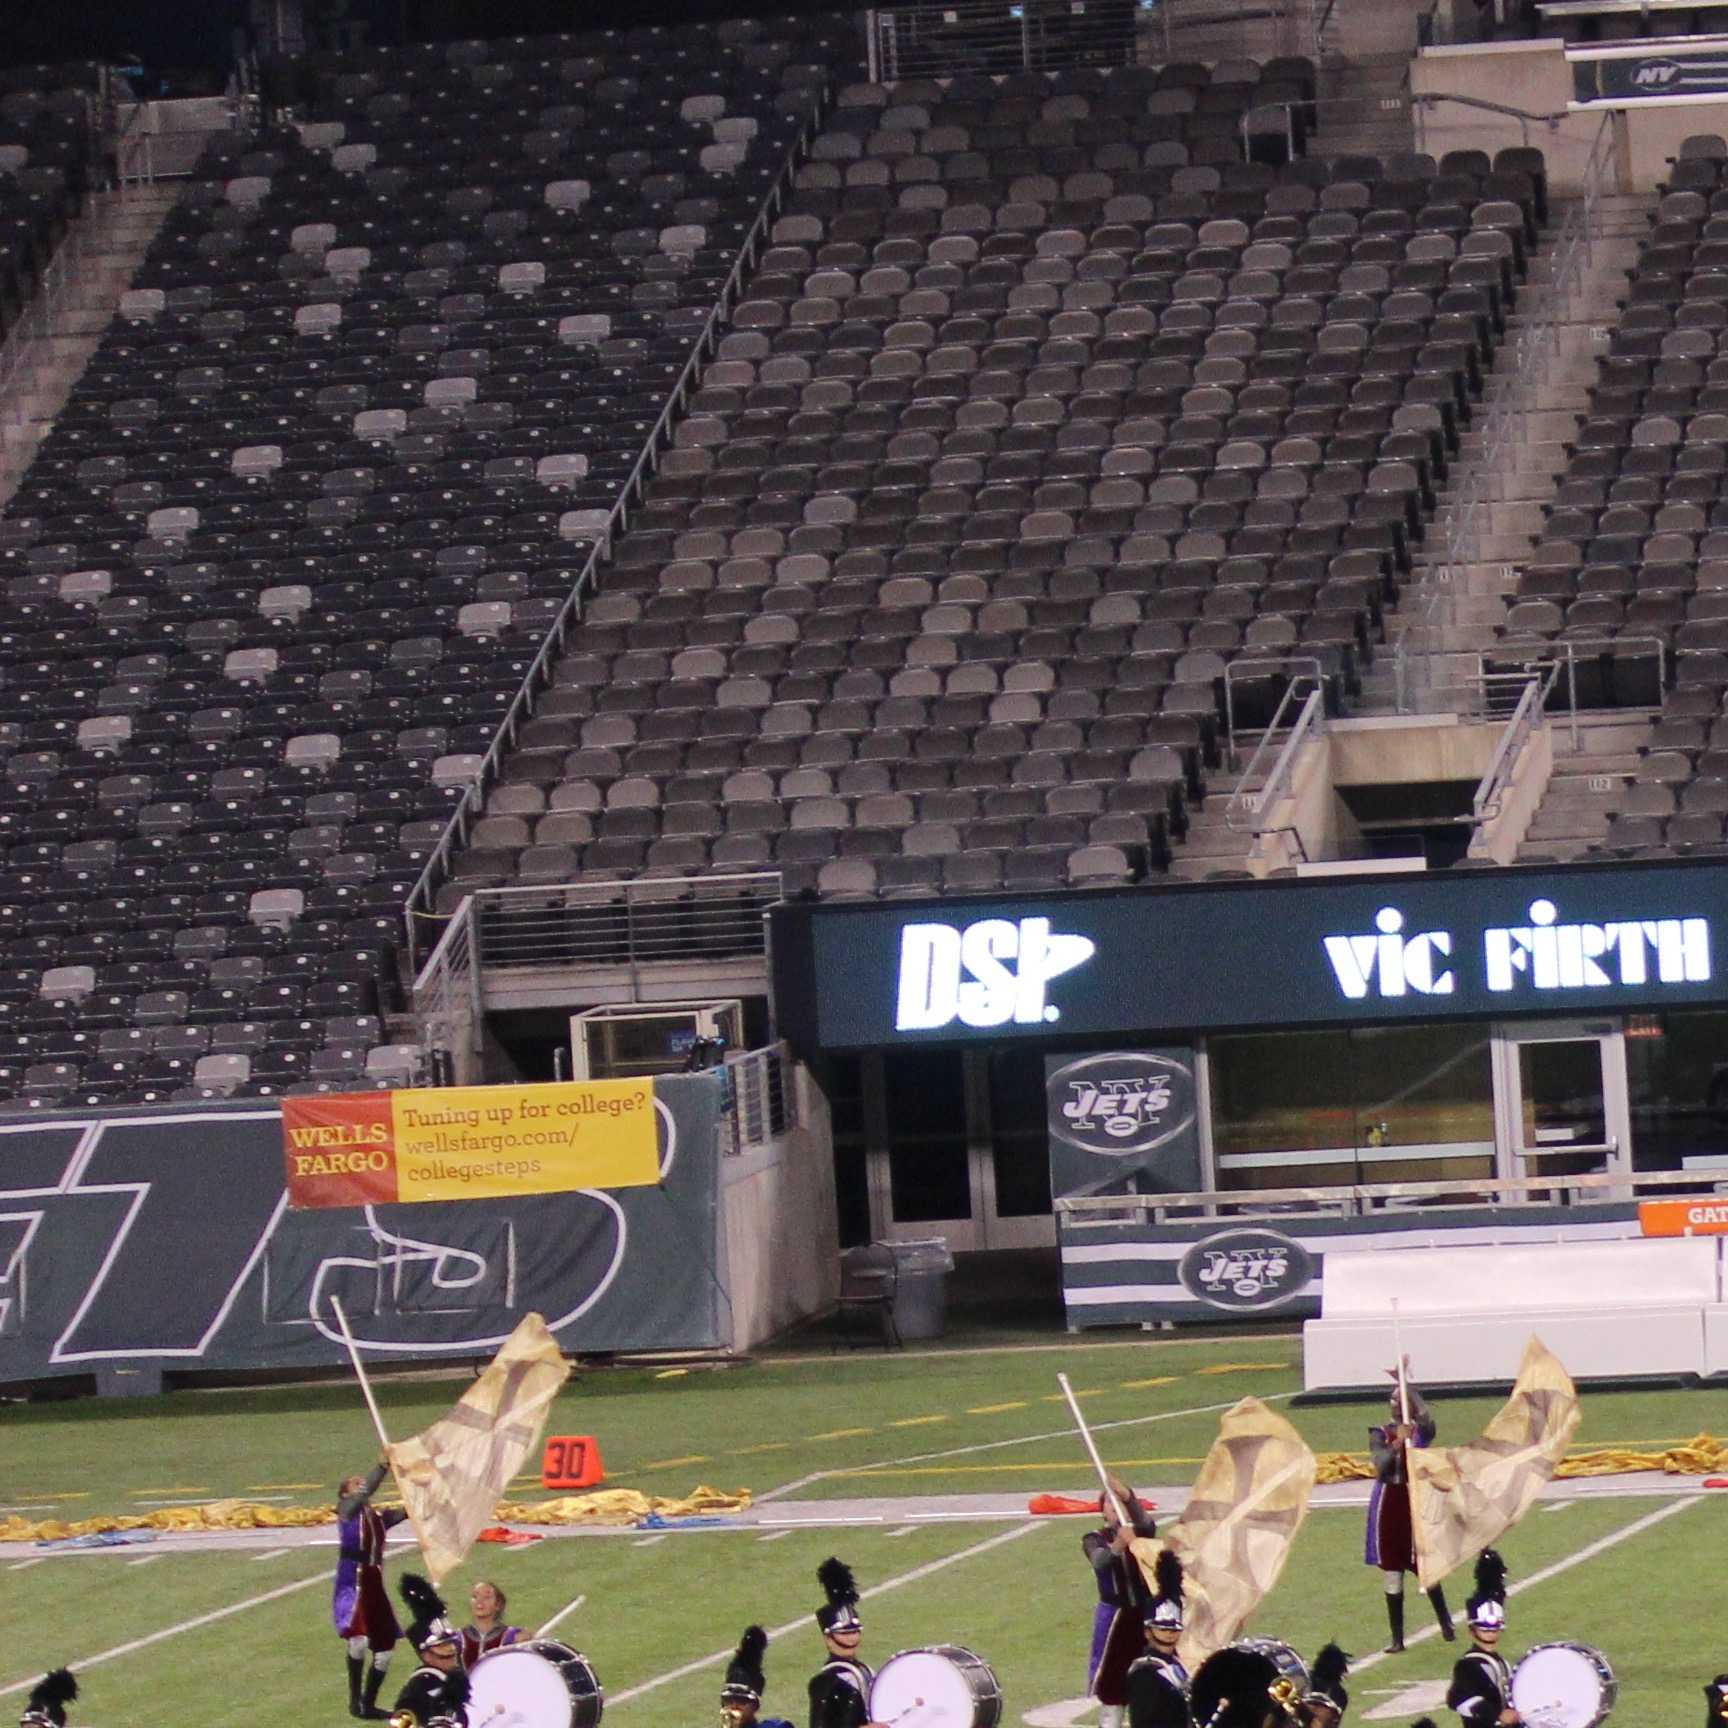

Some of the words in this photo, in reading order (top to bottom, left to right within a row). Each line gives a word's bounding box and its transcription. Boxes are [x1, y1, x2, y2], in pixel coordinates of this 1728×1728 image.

[1634, 67, 1678, 84] NY
[403, 1105, 479, 1129] Tuning
[487, 1104, 513, 1125] up
[520, 1098, 550, 1119] for
[556, 1092, 646, 1118] college?
[1063, 1088, 1171, 1117] JETS
[289, 1123, 388, 1149] WELLS
[405, 1123, 579, 1154] wellsfargo.com/
[295, 1151, 388, 1176] FARGO
[407, 1157, 541, 1183] collegesteps
[1199, 1258, 1288, 1283] JETS
[545, 1441, 586, 1479] 30
